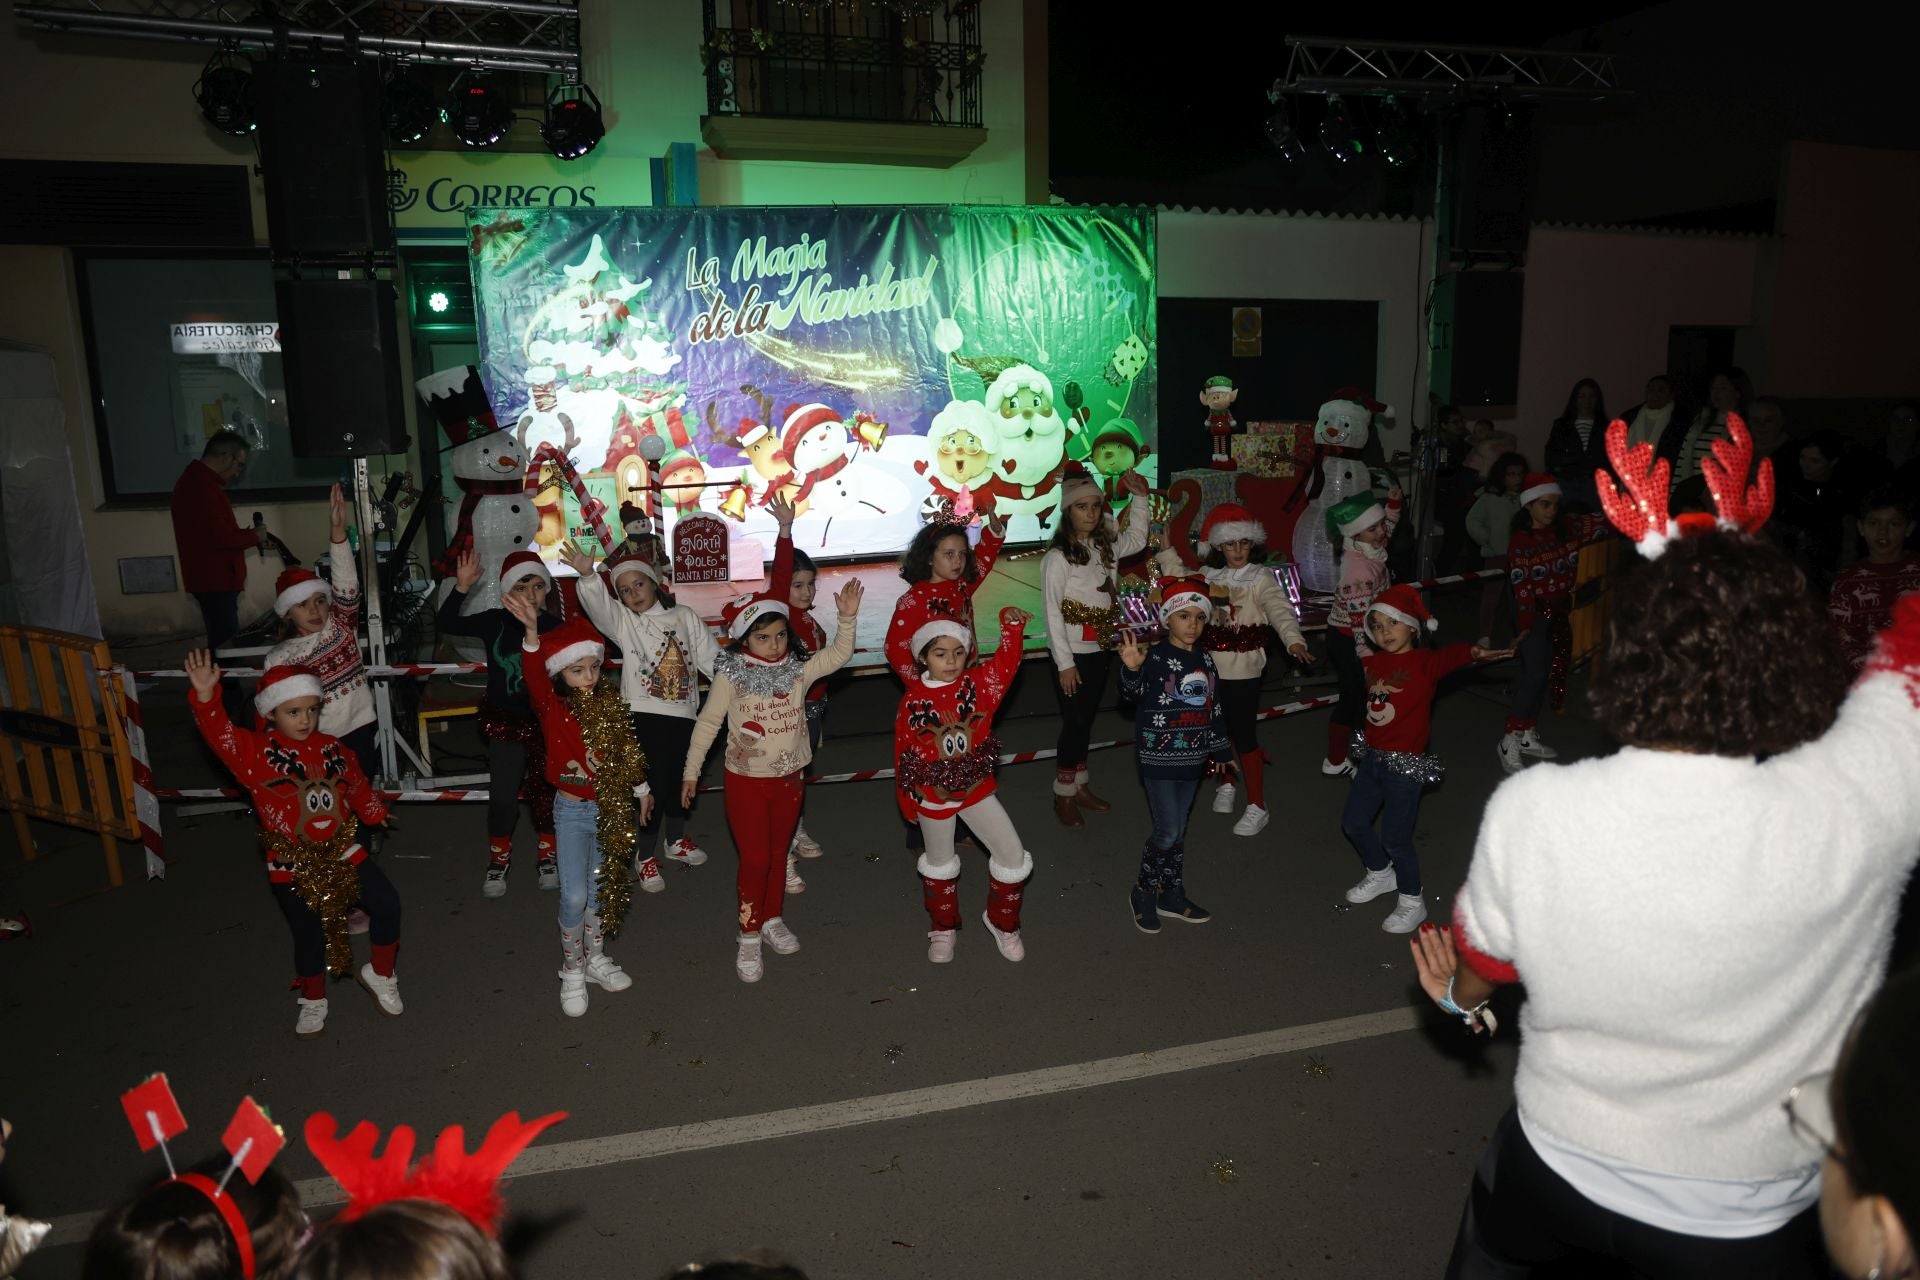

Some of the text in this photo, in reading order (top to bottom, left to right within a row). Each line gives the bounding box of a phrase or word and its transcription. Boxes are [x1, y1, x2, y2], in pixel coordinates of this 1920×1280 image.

[426, 177, 595, 213] CORREOS
[686, 232, 827, 296] La Magia
[770, 254, 939, 330] Navidad
[680, 534, 721, 554] NORTH
[685, 555, 718, 570] POLE
[677, 571, 701, 581] SANTA
[754, 702, 766, 712] all
[768, 699, 790, 709] about
[754, 713, 768, 722] the
